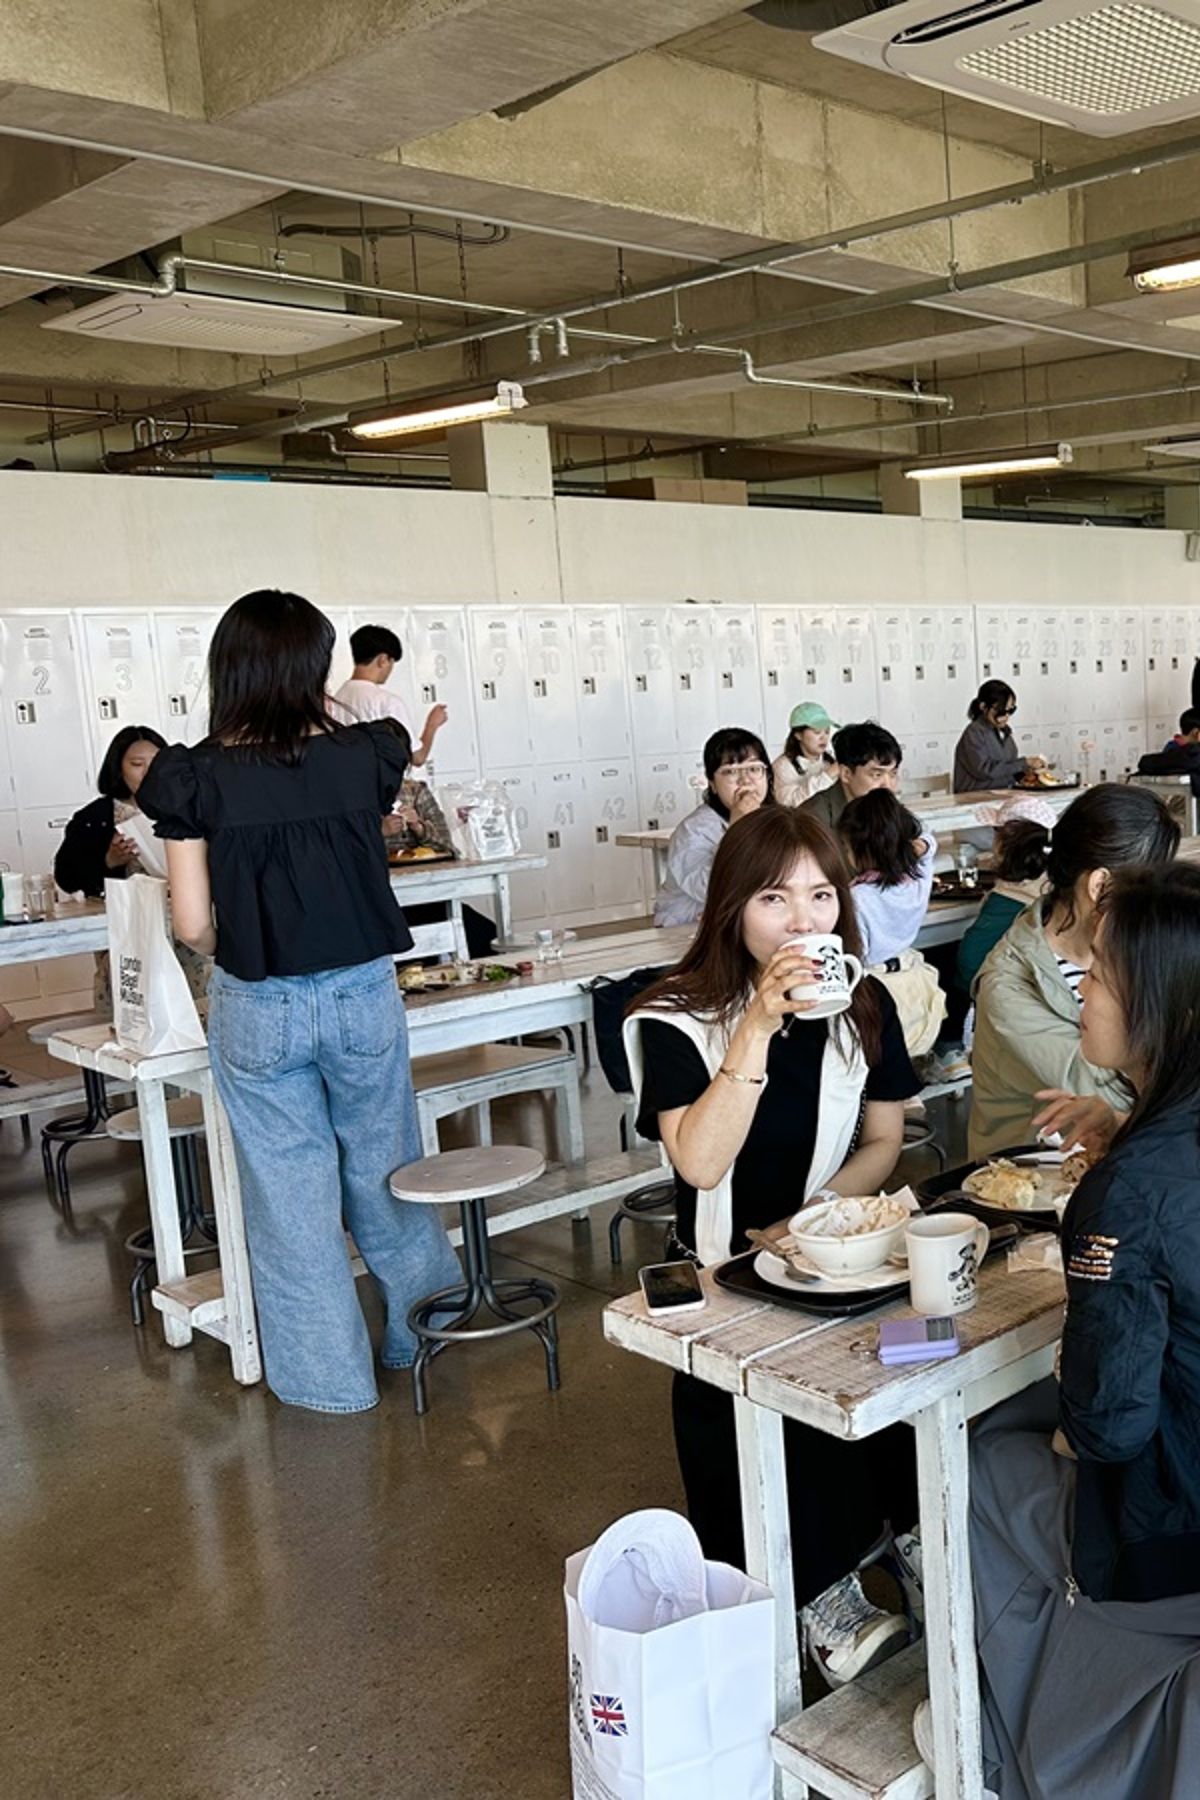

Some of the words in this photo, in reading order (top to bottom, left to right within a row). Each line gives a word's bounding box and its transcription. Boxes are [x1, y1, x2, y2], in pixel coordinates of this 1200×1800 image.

[643, 647, 662, 671] 12
[688, 646, 704, 669] 13
[728, 646, 744, 668] 14
[774, 645, 790, 665] 15
[811, 644, 825, 665] 16
[848, 643, 862, 664] 17
[888, 642, 901, 662] 18
[920, 642, 934, 662] 19
[951, 642, 967, 661] 20
[985, 641, 1000, 660] 21
[1015, 641, 1031, 659] 22
[1043, 640, 1058, 658] 23
[1073, 640, 1086, 657] 24
[1099, 640, 1112, 656] 25
[1124, 640, 1137, 656] 26
[434, 653, 448, 680] 8
[494, 651, 506, 677] 9
[539, 649, 560, 674] 10
[591, 649, 606, 672] 11
[32, 665, 52, 696] 2
[115, 664, 132, 691] 3
[553, 801, 575, 825] 41
[602, 796, 626, 820] 42
[654, 791, 676, 814] 43
[516, 806, 529, 831] 0
